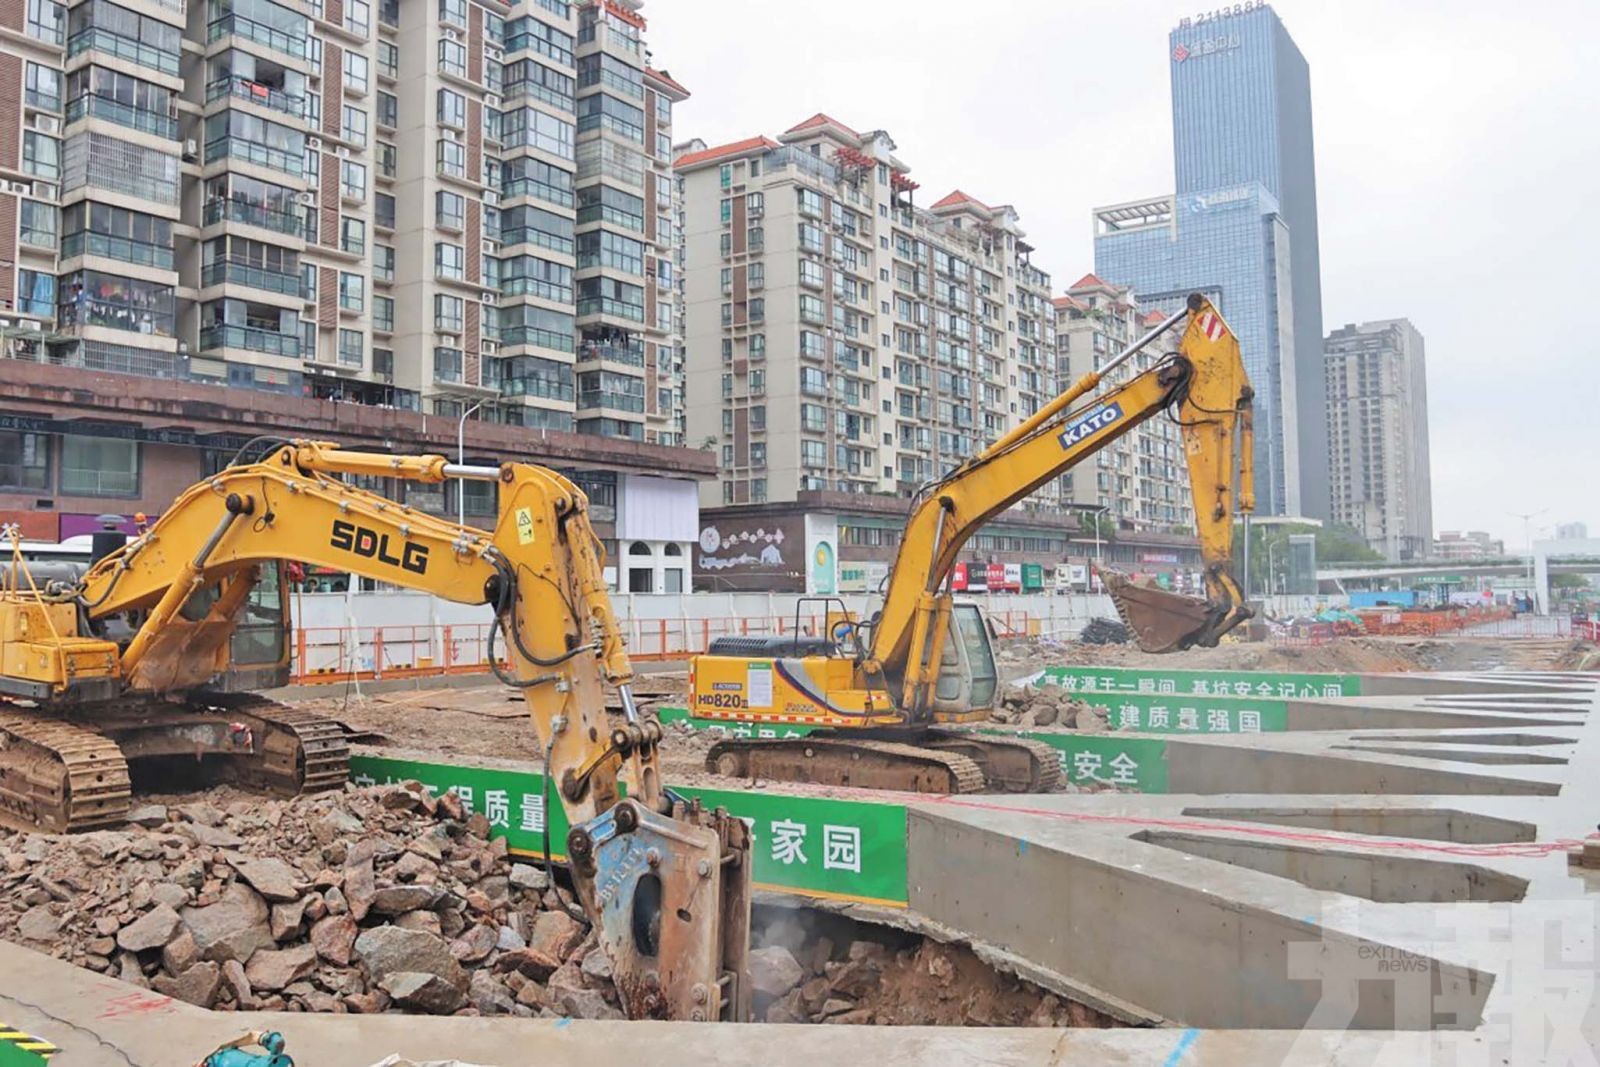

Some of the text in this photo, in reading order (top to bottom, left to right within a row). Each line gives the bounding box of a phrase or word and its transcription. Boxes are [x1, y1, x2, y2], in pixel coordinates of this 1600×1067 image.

[1063, 408, 1117, 446] KATO
[330, 519, 429, 575] SDLG
[735, 813, 861, 874] 家园
